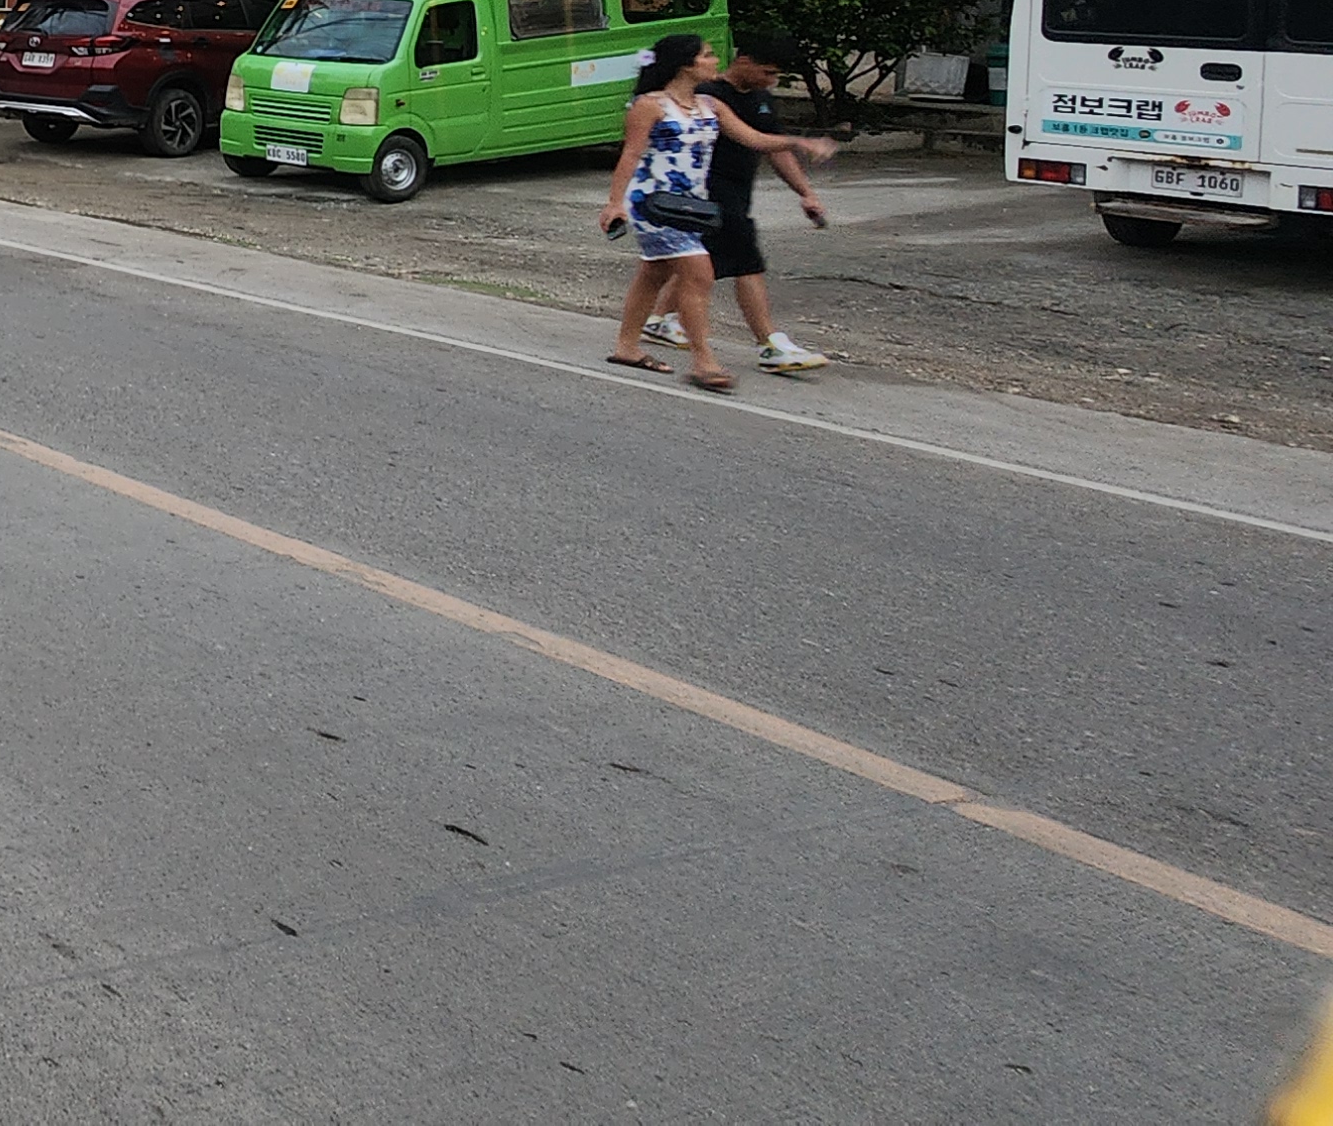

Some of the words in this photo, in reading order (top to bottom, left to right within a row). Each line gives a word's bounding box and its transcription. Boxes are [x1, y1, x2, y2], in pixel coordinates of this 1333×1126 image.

[1052, 93, 1164, 122] 점보크랩
[1154, 169, 1185, 185] GBF
[1196, 174, 1240, 192] 1060
